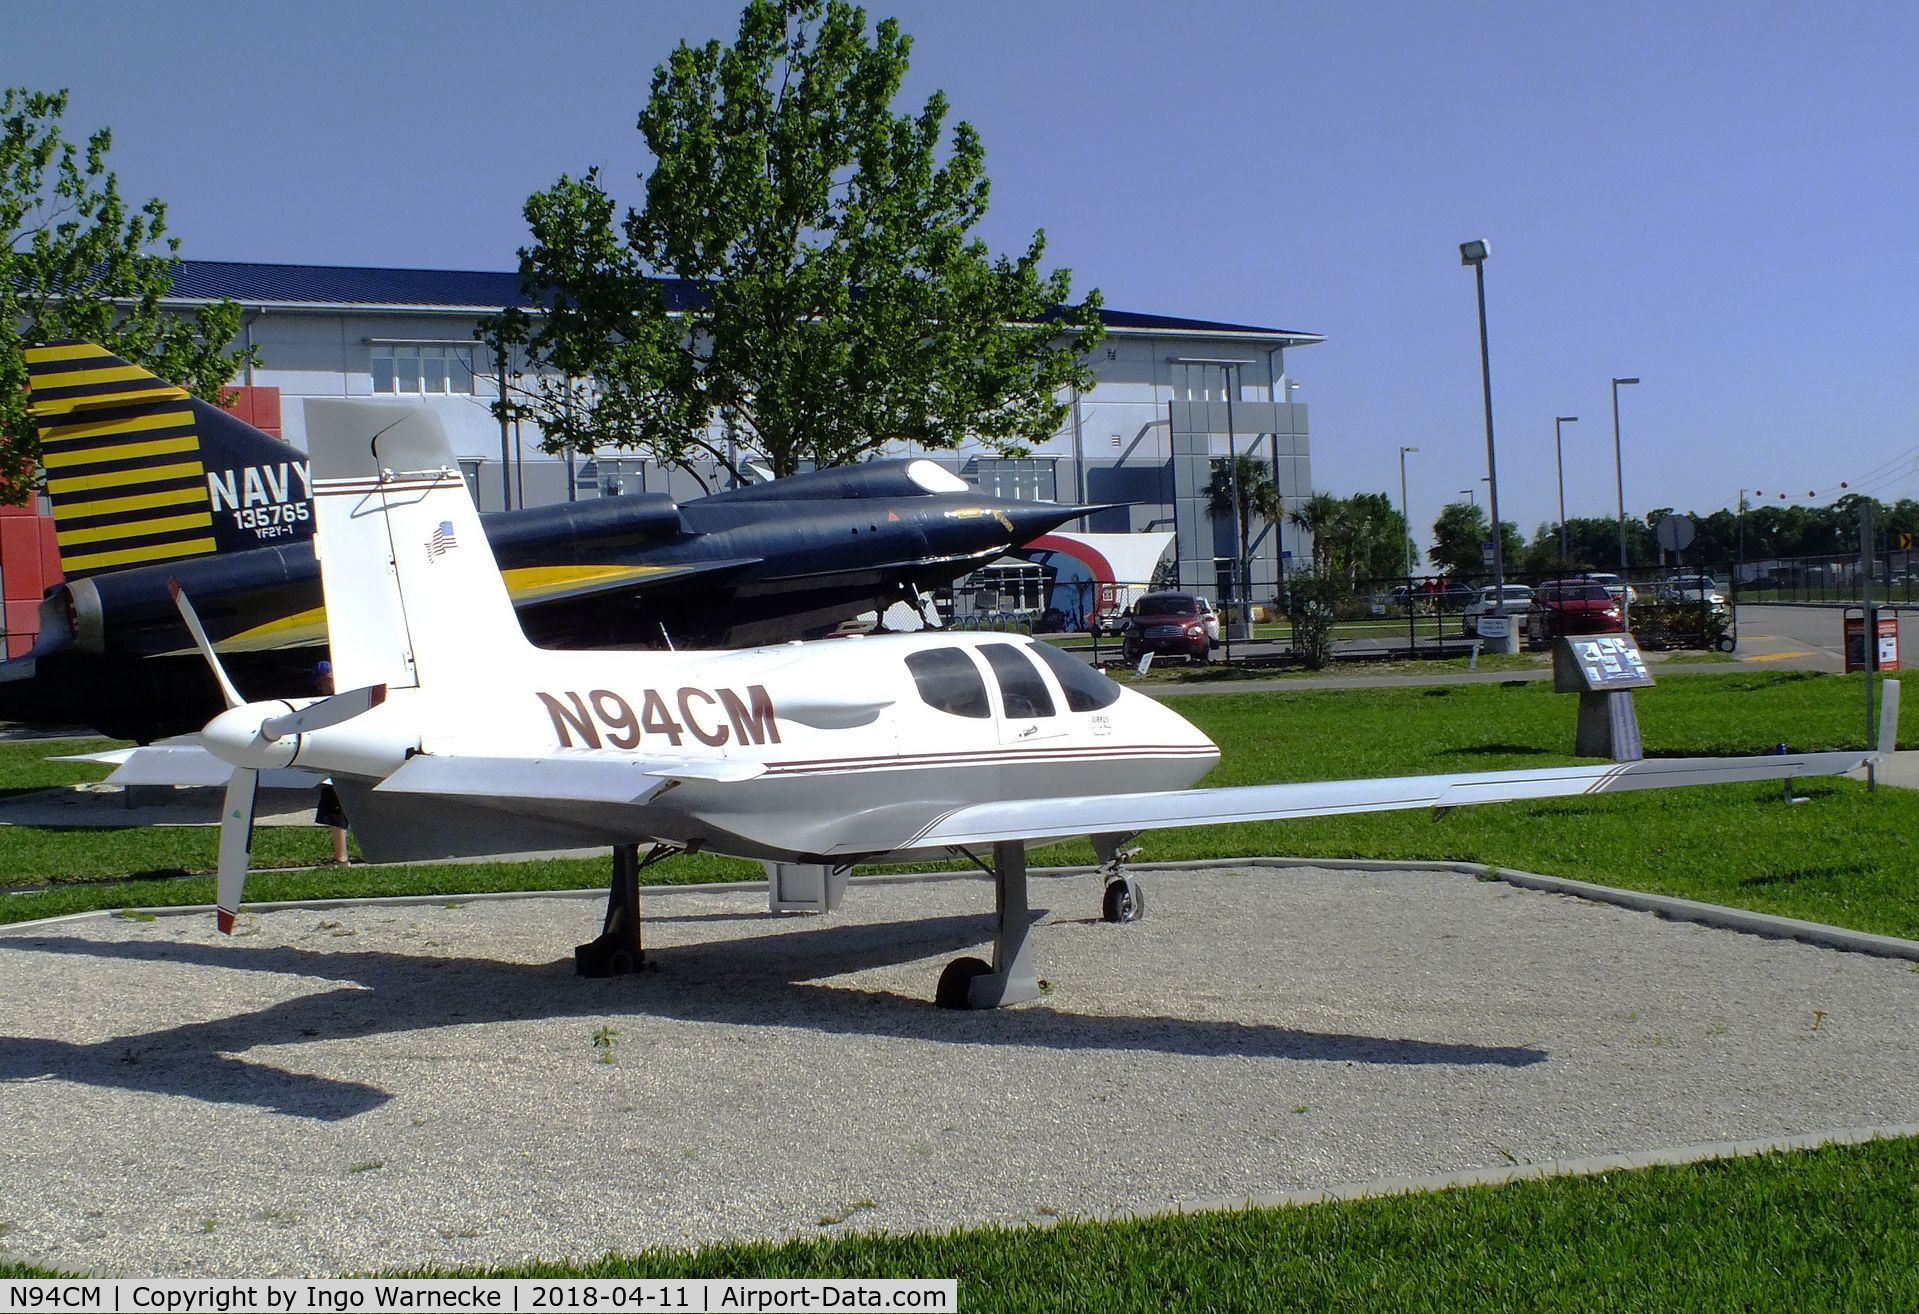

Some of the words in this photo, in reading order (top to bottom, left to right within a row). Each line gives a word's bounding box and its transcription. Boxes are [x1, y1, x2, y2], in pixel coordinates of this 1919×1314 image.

[207, 460, 313, 512] NAVY
[233, 502, 310, 530] 135765
[255, 525, 294, 539] YF2Y-1
[535, 685, 782, 750] N94CM
